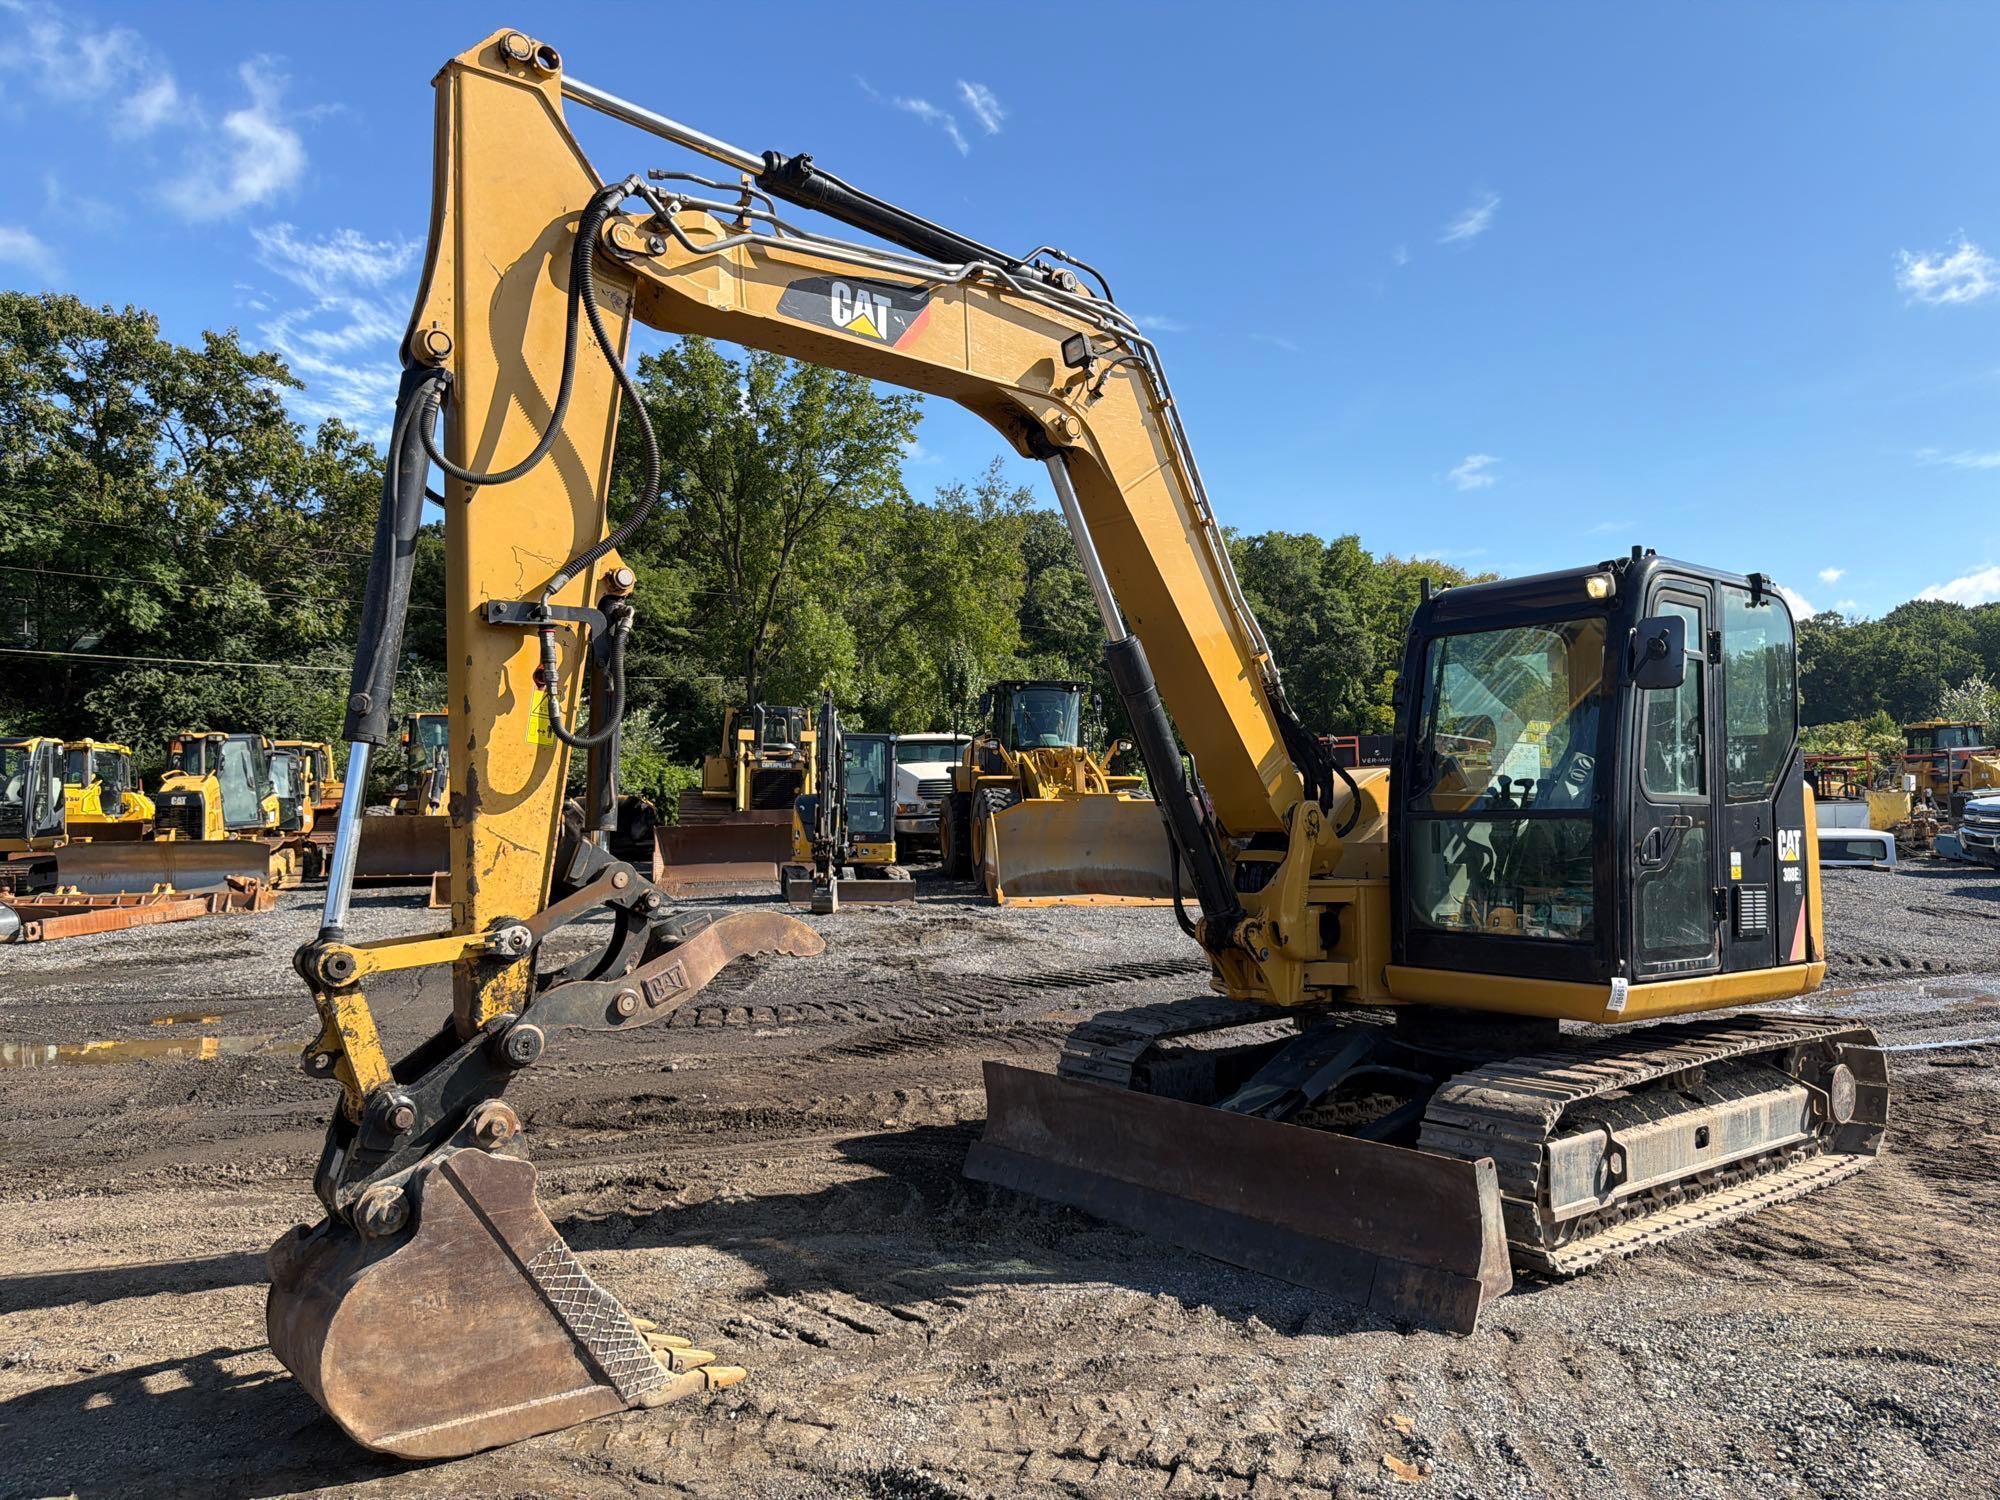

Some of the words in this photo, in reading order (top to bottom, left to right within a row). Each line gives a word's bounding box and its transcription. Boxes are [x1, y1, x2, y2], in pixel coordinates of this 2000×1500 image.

[831, 281, 892, 340] CAT
[170, 796, 187, 805] CAT
[1777, 829, 1801, 861] CAT
[651, 964, 684, 999] CAT
